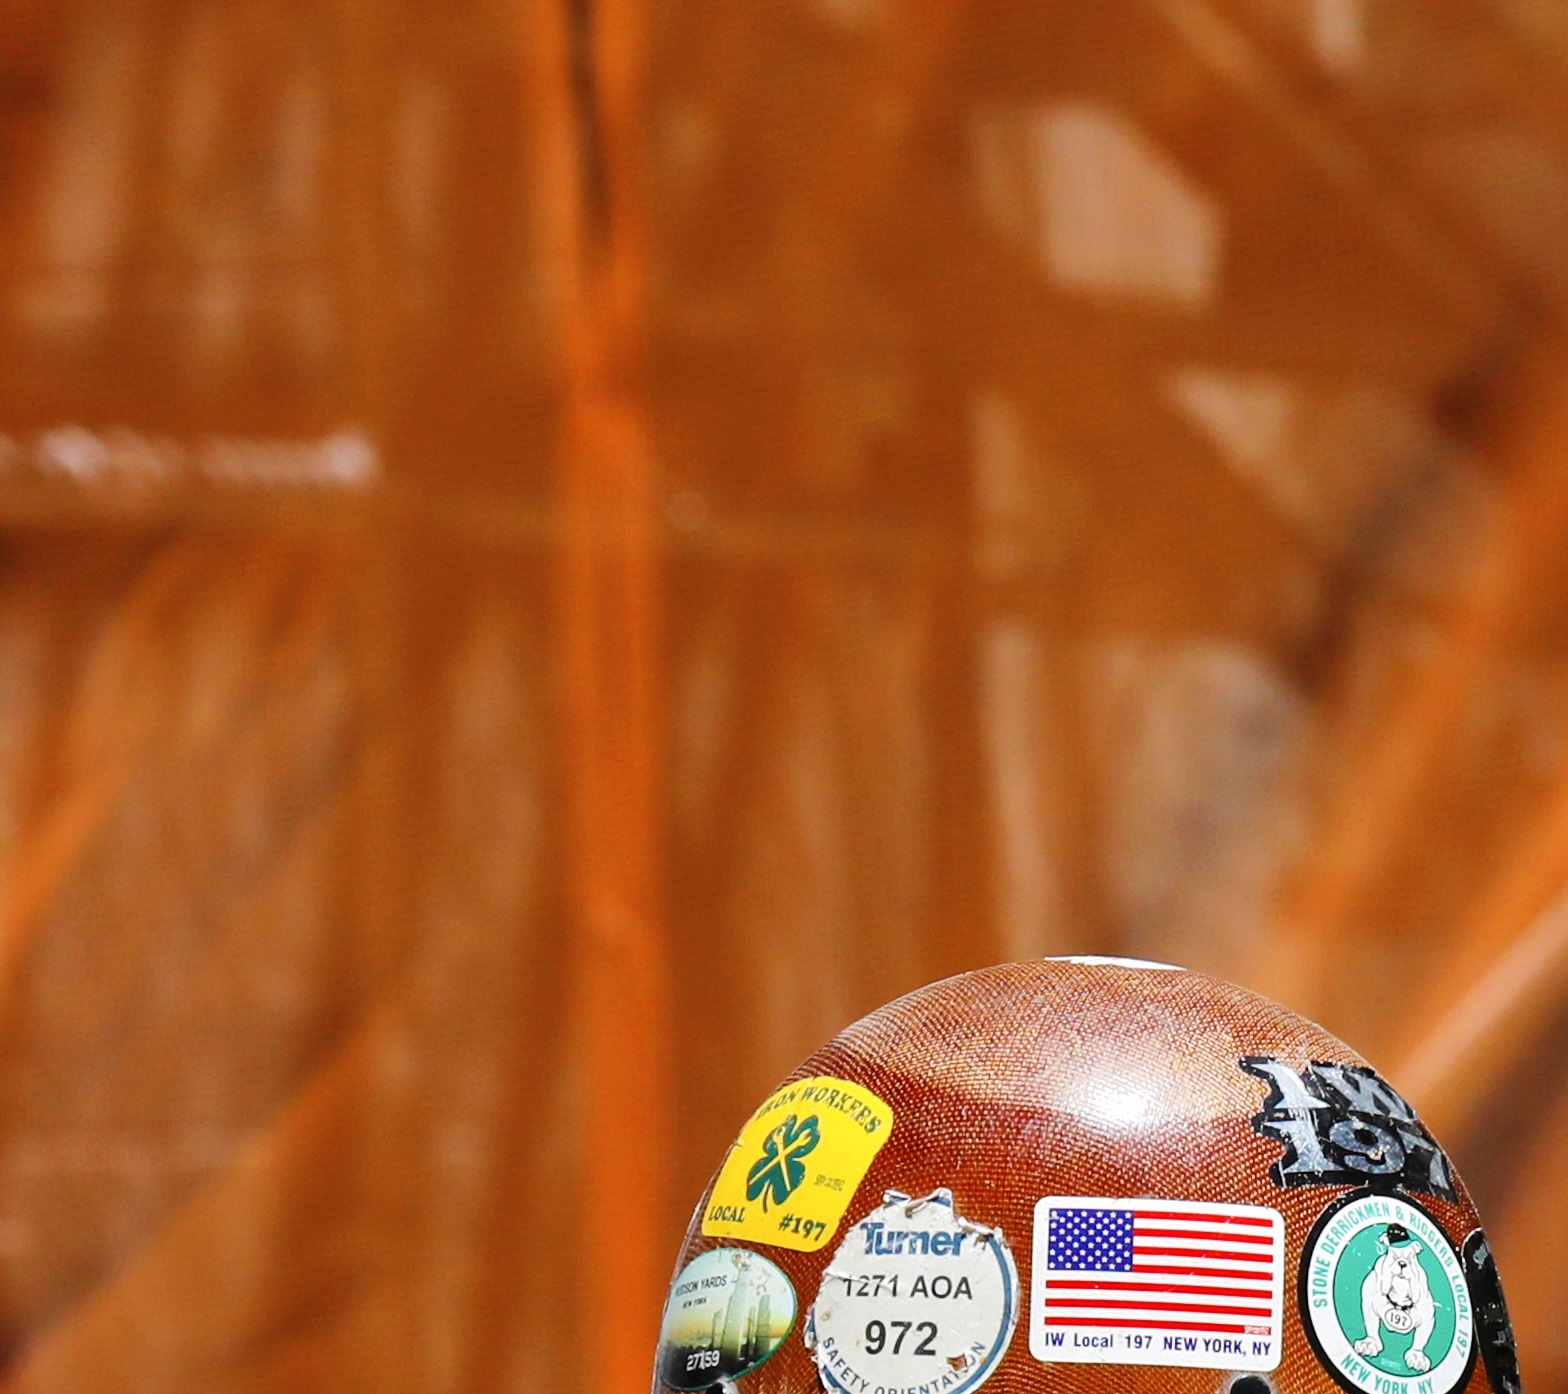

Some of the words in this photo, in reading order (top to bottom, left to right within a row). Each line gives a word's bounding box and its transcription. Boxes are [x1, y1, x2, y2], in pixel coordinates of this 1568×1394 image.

[802, 1086, 882, 1134] WORKERS
[1263, 1118, 1450, 1191] 197
[708, 1206, 746, 1222] LOCAL
[778, 1213, 827, 1242] #197
[1321, 1202, 1391, 1254] DERRICKMEN
[1395, 1206, 1404, 1219] &
[860, 1222, 966, 1256] Turner
[1409, 1213, 1453, 1268] RIGGERS
[700, 1275, 728, 1289] YARDS
[843, 1274, 898, 1298] 1271
[910, 1275, 973, 1300] AOA
[1313, 1255, 1332, 1308] STONE
[1452, 1274, 1469, 1321] LOCAL
[1389, 1311, 1408, 1325] 197
[864, 1320, 939, 1356] 972
[1045, 1332, 1065, 1347] IW
[1074, 1333, 1114, 1348] Local
[1125, 1335, 1153, 1350] 197
[1163, 1336, 1198, 1352] NEW
[1203, 1338, 1247, 1357] YORK,
[1252, 1342, 1272, 1356] NY
[1454, 1329, 1469, 1359] 197
[823, 1337, 870, 1393] SAFETY
[1341, 1354, 1370, 1384] NEW
